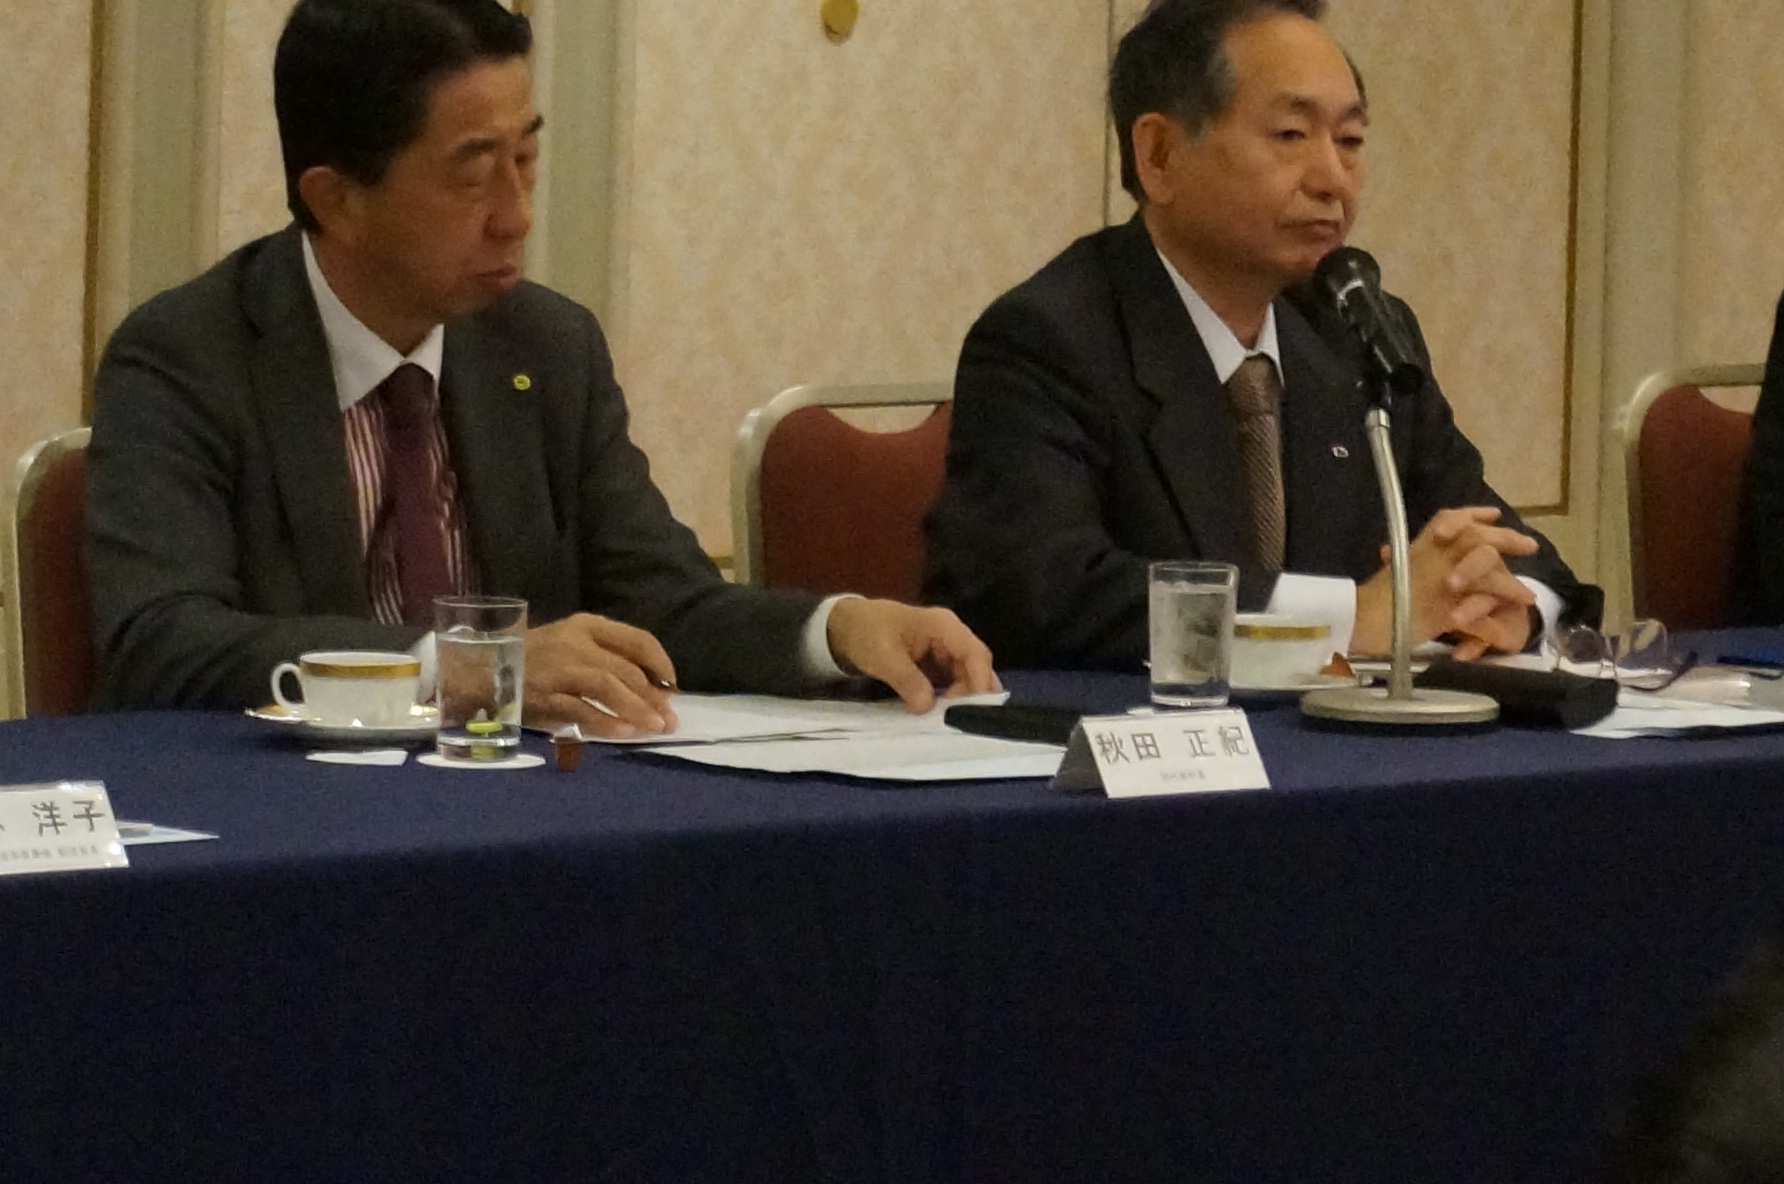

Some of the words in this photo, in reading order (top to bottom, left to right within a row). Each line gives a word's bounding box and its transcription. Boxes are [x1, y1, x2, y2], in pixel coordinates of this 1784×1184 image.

[1095, 731, 1162, 764] 秋田
[1183, 725, 1250, 759] 正紀
[31, 800, 106, 837] 洋子
